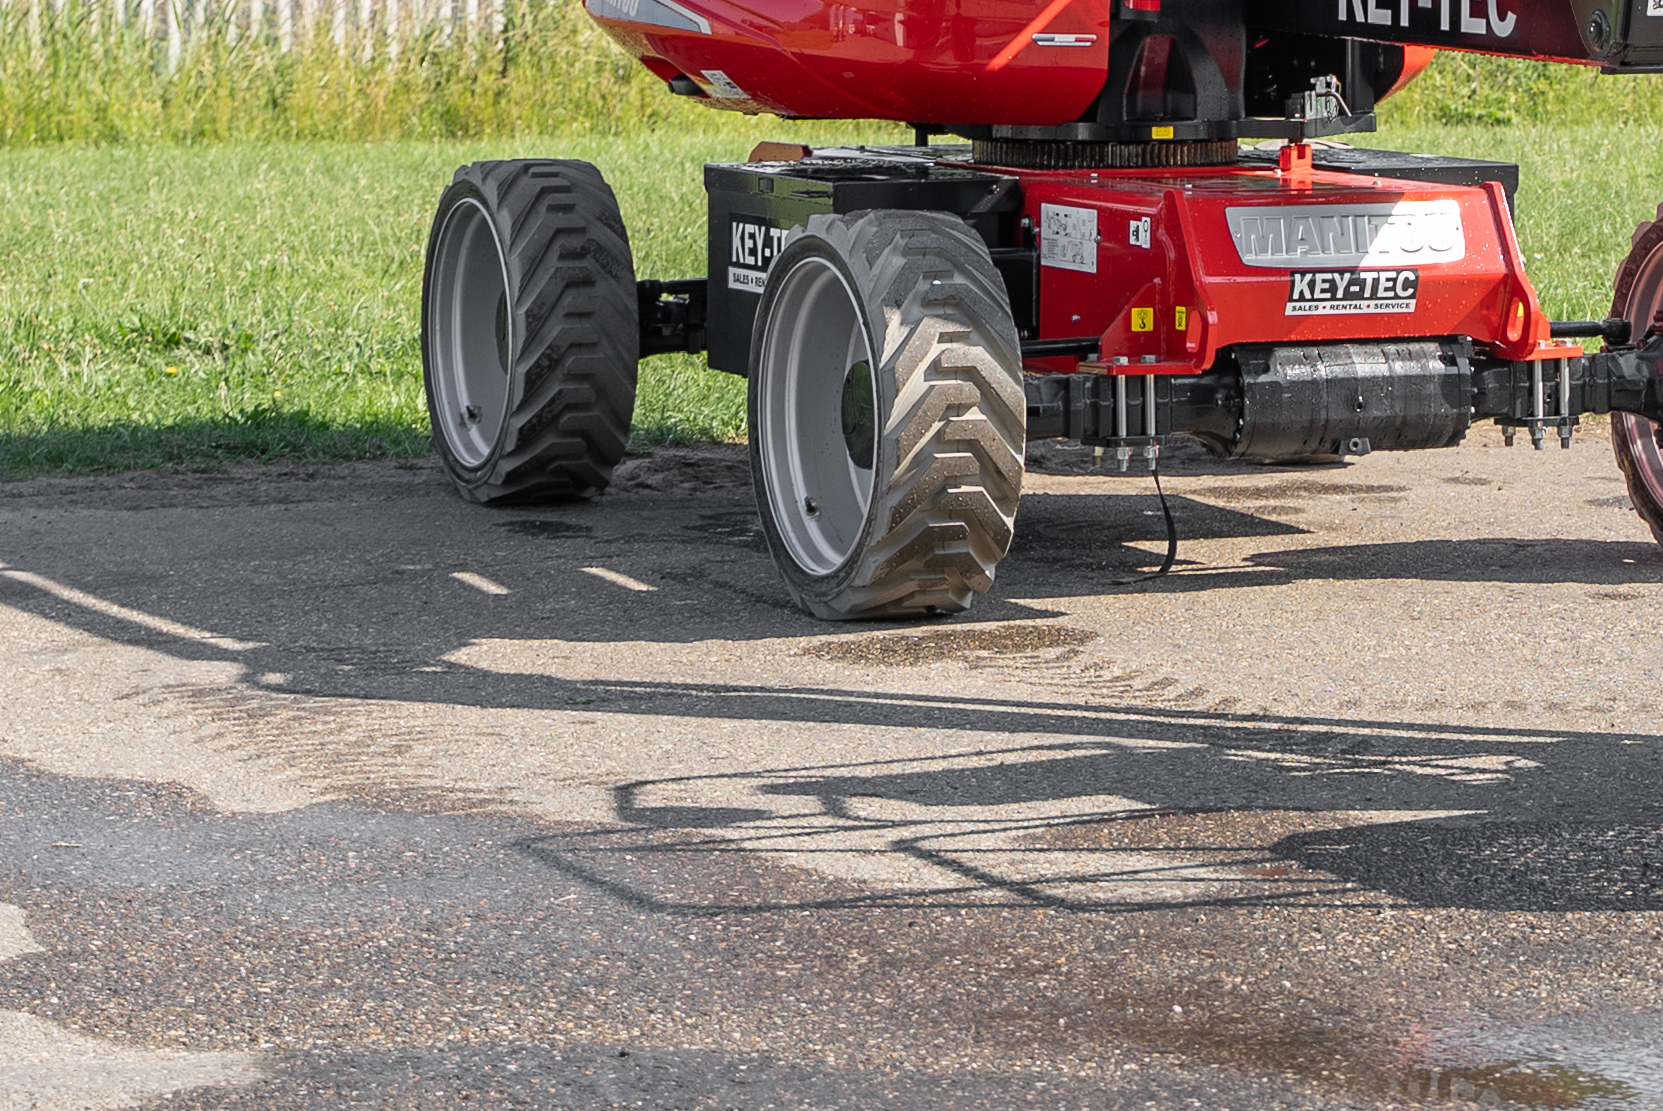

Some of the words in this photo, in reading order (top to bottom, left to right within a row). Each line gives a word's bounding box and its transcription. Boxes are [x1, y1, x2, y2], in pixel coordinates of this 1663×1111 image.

[733, 272, 749, 286] SALES
[1292, 270, 1416, 300] KEY-TEC
[1291, 304, 1319, 312] SALES
[1329, 303, 1363, 311] RENTAL
[1373, 302, 1411, 310] SERVICE
